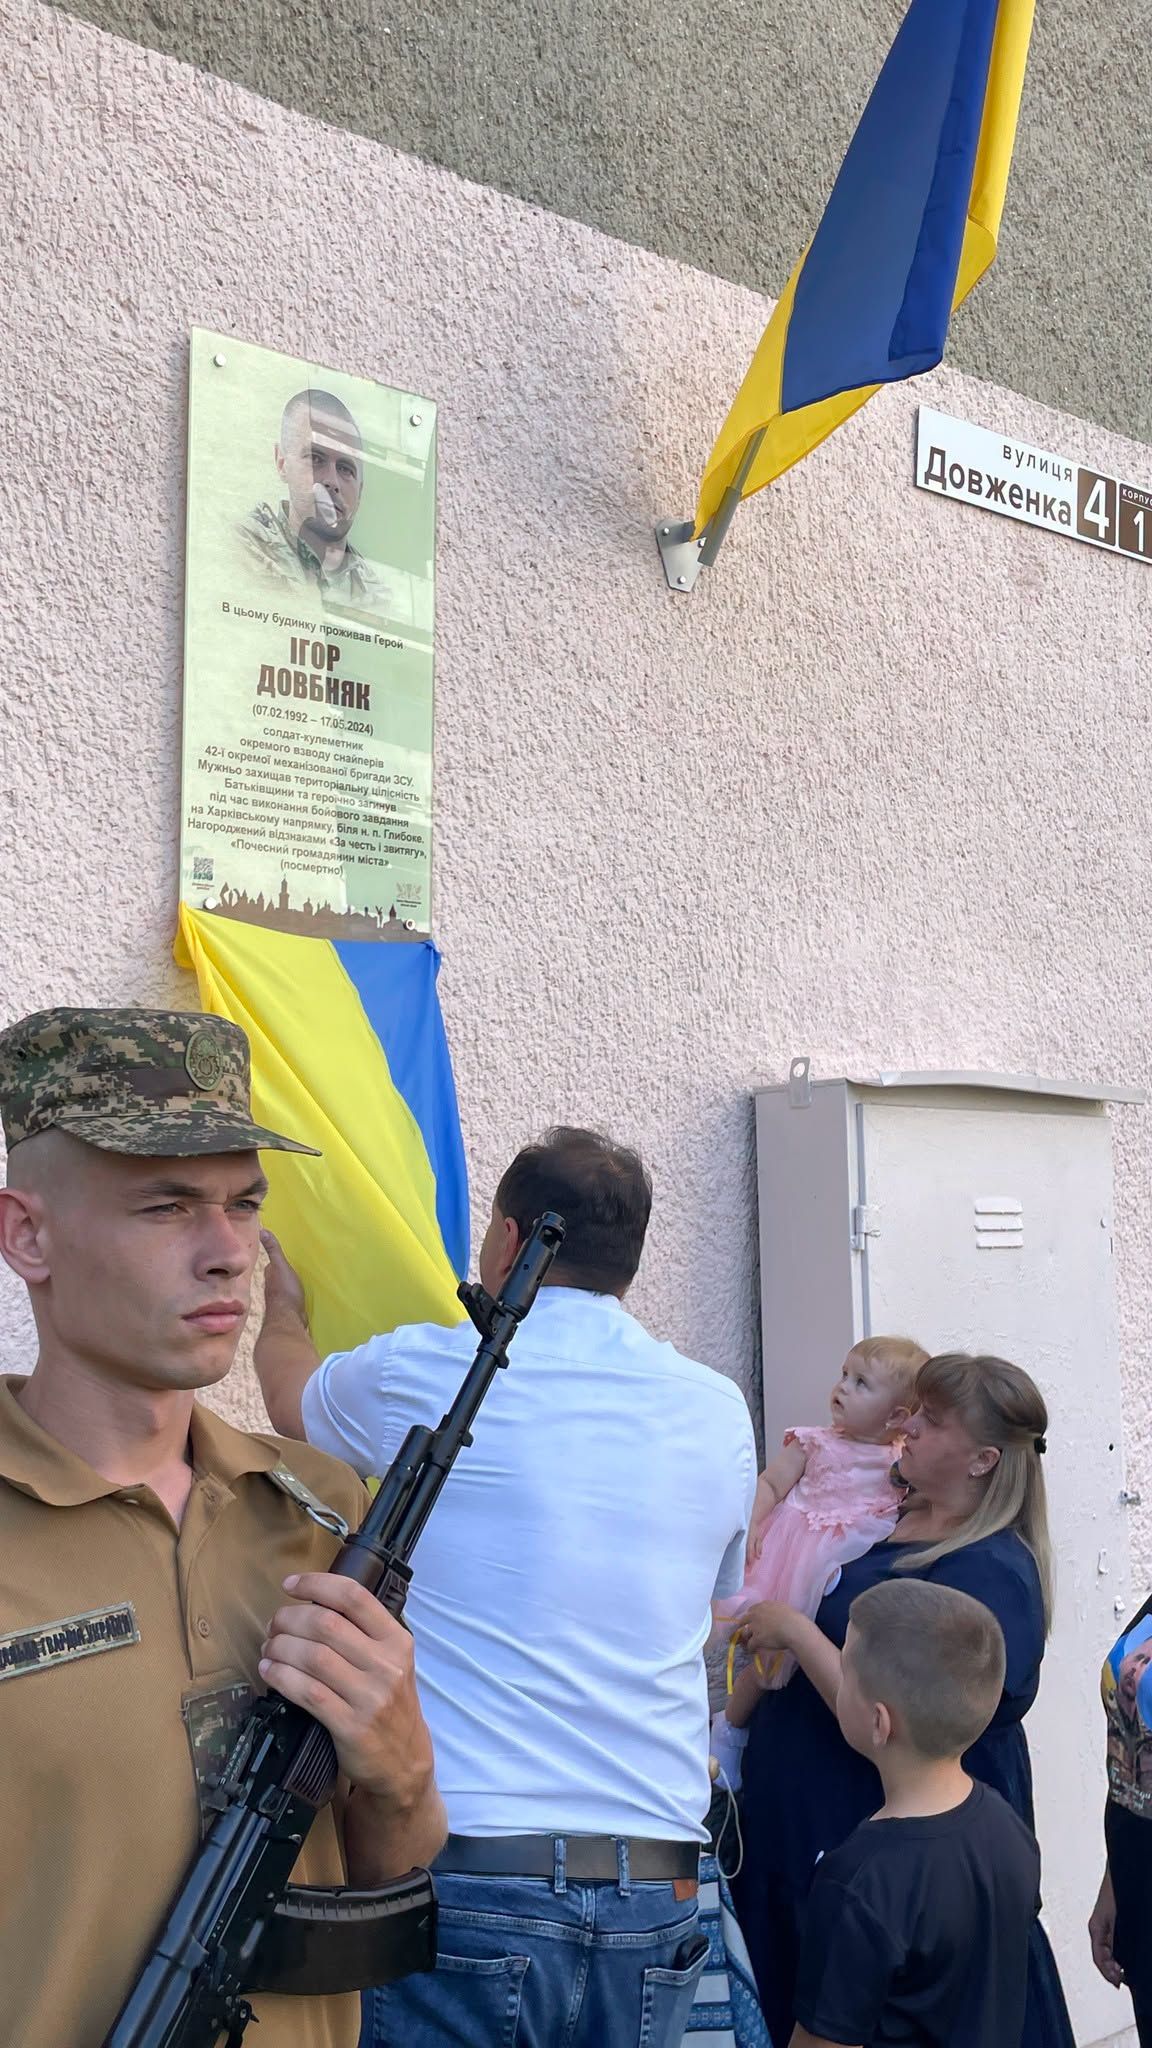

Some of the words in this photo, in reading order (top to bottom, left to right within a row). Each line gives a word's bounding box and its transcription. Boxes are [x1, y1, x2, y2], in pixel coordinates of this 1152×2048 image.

[1003, 445, 1073, 483] вулиця
[924, 446, 1071, 527] Довженка
[1083, 479, 1110, 539] 4
[1133, 510, 1145, 553] 1
[222, 602, 230, 613] В
[233, 606, 269, 623] цьому
[272, 612, 316, 633] будинку
[320, 625, 371, 643] проживав
[374, 634, 404, 649] Герой
[290, 636, 340, 672] ІГОР
[256, 664, 371, 711] ДОВБНЯК
[252, 704, 308, 724] (07.02.1992
[320, 716, 374, 737] 17.05.2024)
[263, 727, 364, 751] солдат-кулеметник
[205, 746, 225, 758] 42-ї
[227, 751, 271, 764] окремої
[274, 758, 347, 777] механізованої
[350, 768, 391, 784] бригади
[240, 738, 291, 754] окремого
[294, 748, 331, 762] взводу
[333, 753, 384, 769] снайперів
[198, 759, 242, 774] Мужньо
[245, 768, 292, 783] захищав
[294, 776, 369, 796] територіальну
[372, 787, 420, 802] цілісність
[224, 777, 294, 797] Батьківщини
[297, 790, 308, 800] та
[358, 799, 397, 813] загинув
[191, 805, 203, 814] на
[207, 805, 280, 826] Харківському
[283, 819, 334, 833] напрямку,
[337, 823, 358, 835] біля
[383, 828, 425, 844] Глибоке.
[210, 791, 227, 804] під
[230, 795, 248, 806] час
[252, 799, 308, 814] виконання
[311, 805, 360, 821] бойового
[362, 813, 409, 828] завдання
[187, 817, 266, 838] Нагороджений
[269, 829, 326, 845] відзнаками
[329, 836, 346, 848] «За
[349, 840, 376, 852] честь
[231, 838, 289, 855] «Почесний
[292, 847, 355, 864] громадянин
[358, 855, 390, 867] міста»
[280, 859, 344, 877] (посмертно)
